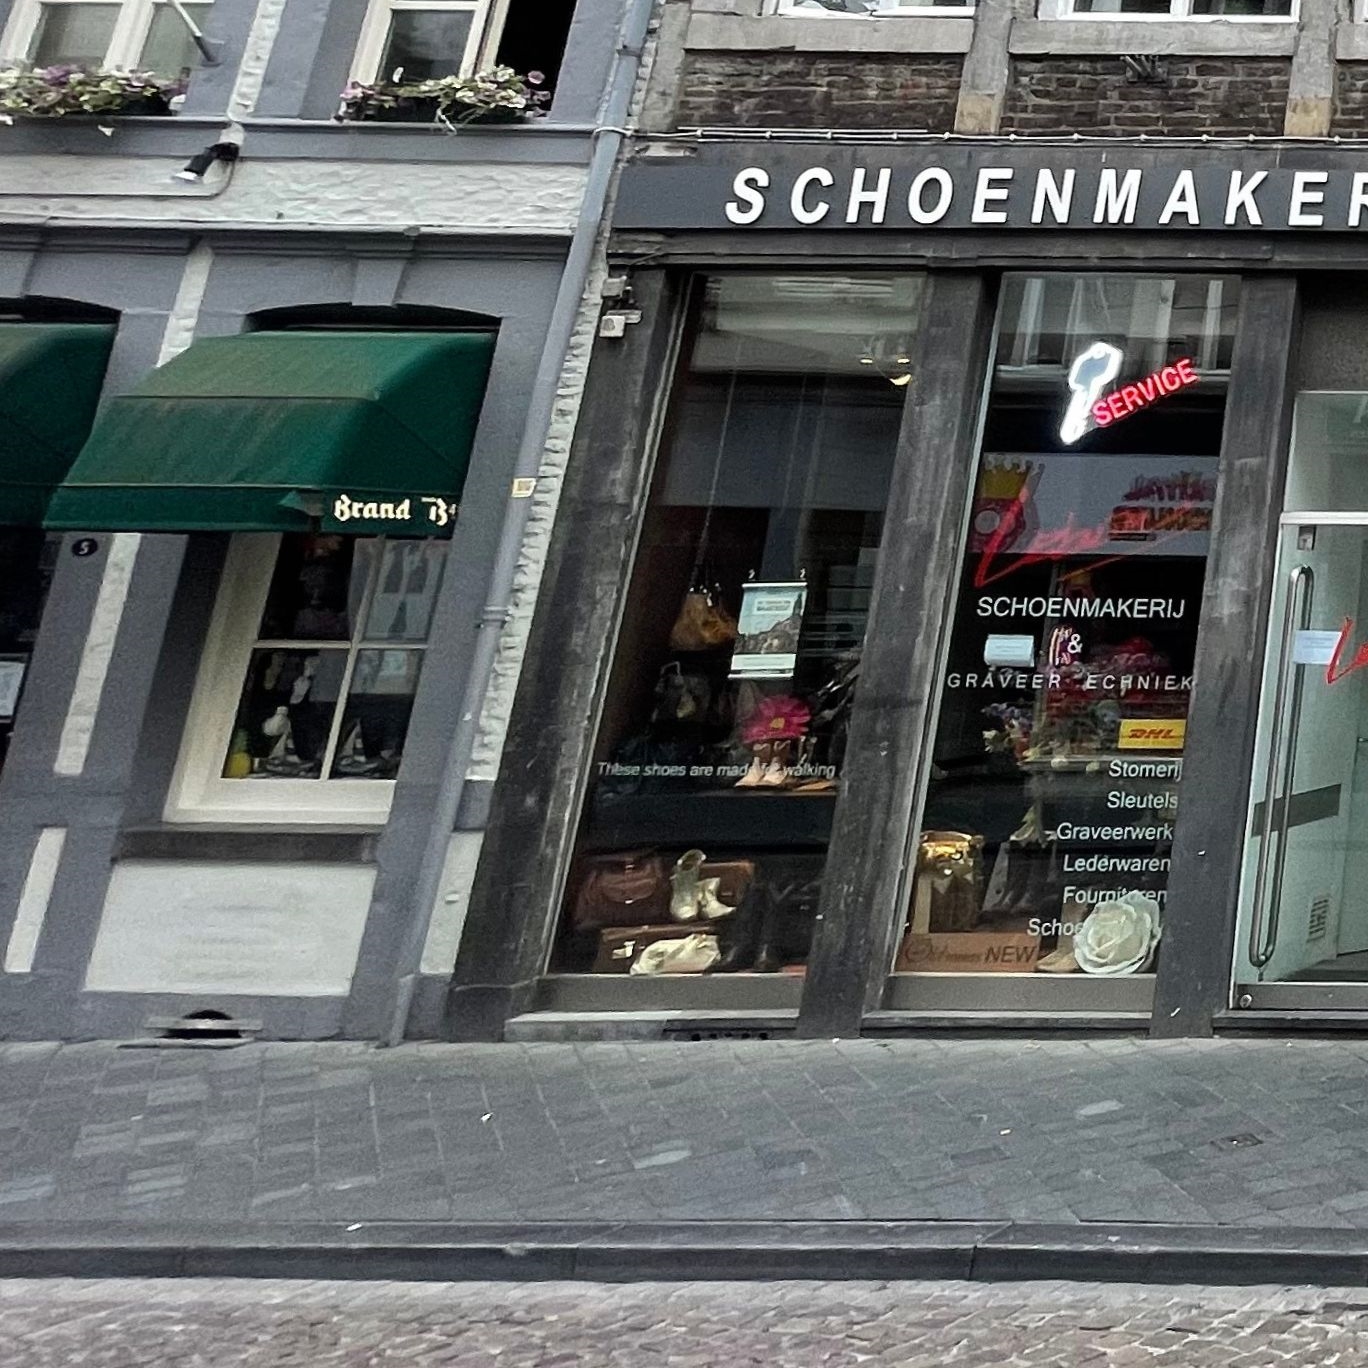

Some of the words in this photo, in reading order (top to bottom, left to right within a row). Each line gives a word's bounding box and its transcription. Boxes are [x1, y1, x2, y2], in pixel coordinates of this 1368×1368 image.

[1092, 358, 1199, 426] SERVICE
[334, 494, 411, 522] Brand
[976, 596, 1186, 619] SCHOENMAKERIJ
[1129, 728, 1177, 739] DHL
[598, 762, 641, 776] These
[642, 763, 687, 776] shoes
[690, 764, 714, 777] are
[716, 762, 751, 777] mad
[1109, 759, 1183, 782] Stomerij
[1107, 791, 1179, 809] Sleutels
[1057, 822, 1174, 840] Graveerwerk
[1063, 854, 1171, 872] Lederwaren
[984, 946, 1037, 963] NEW
